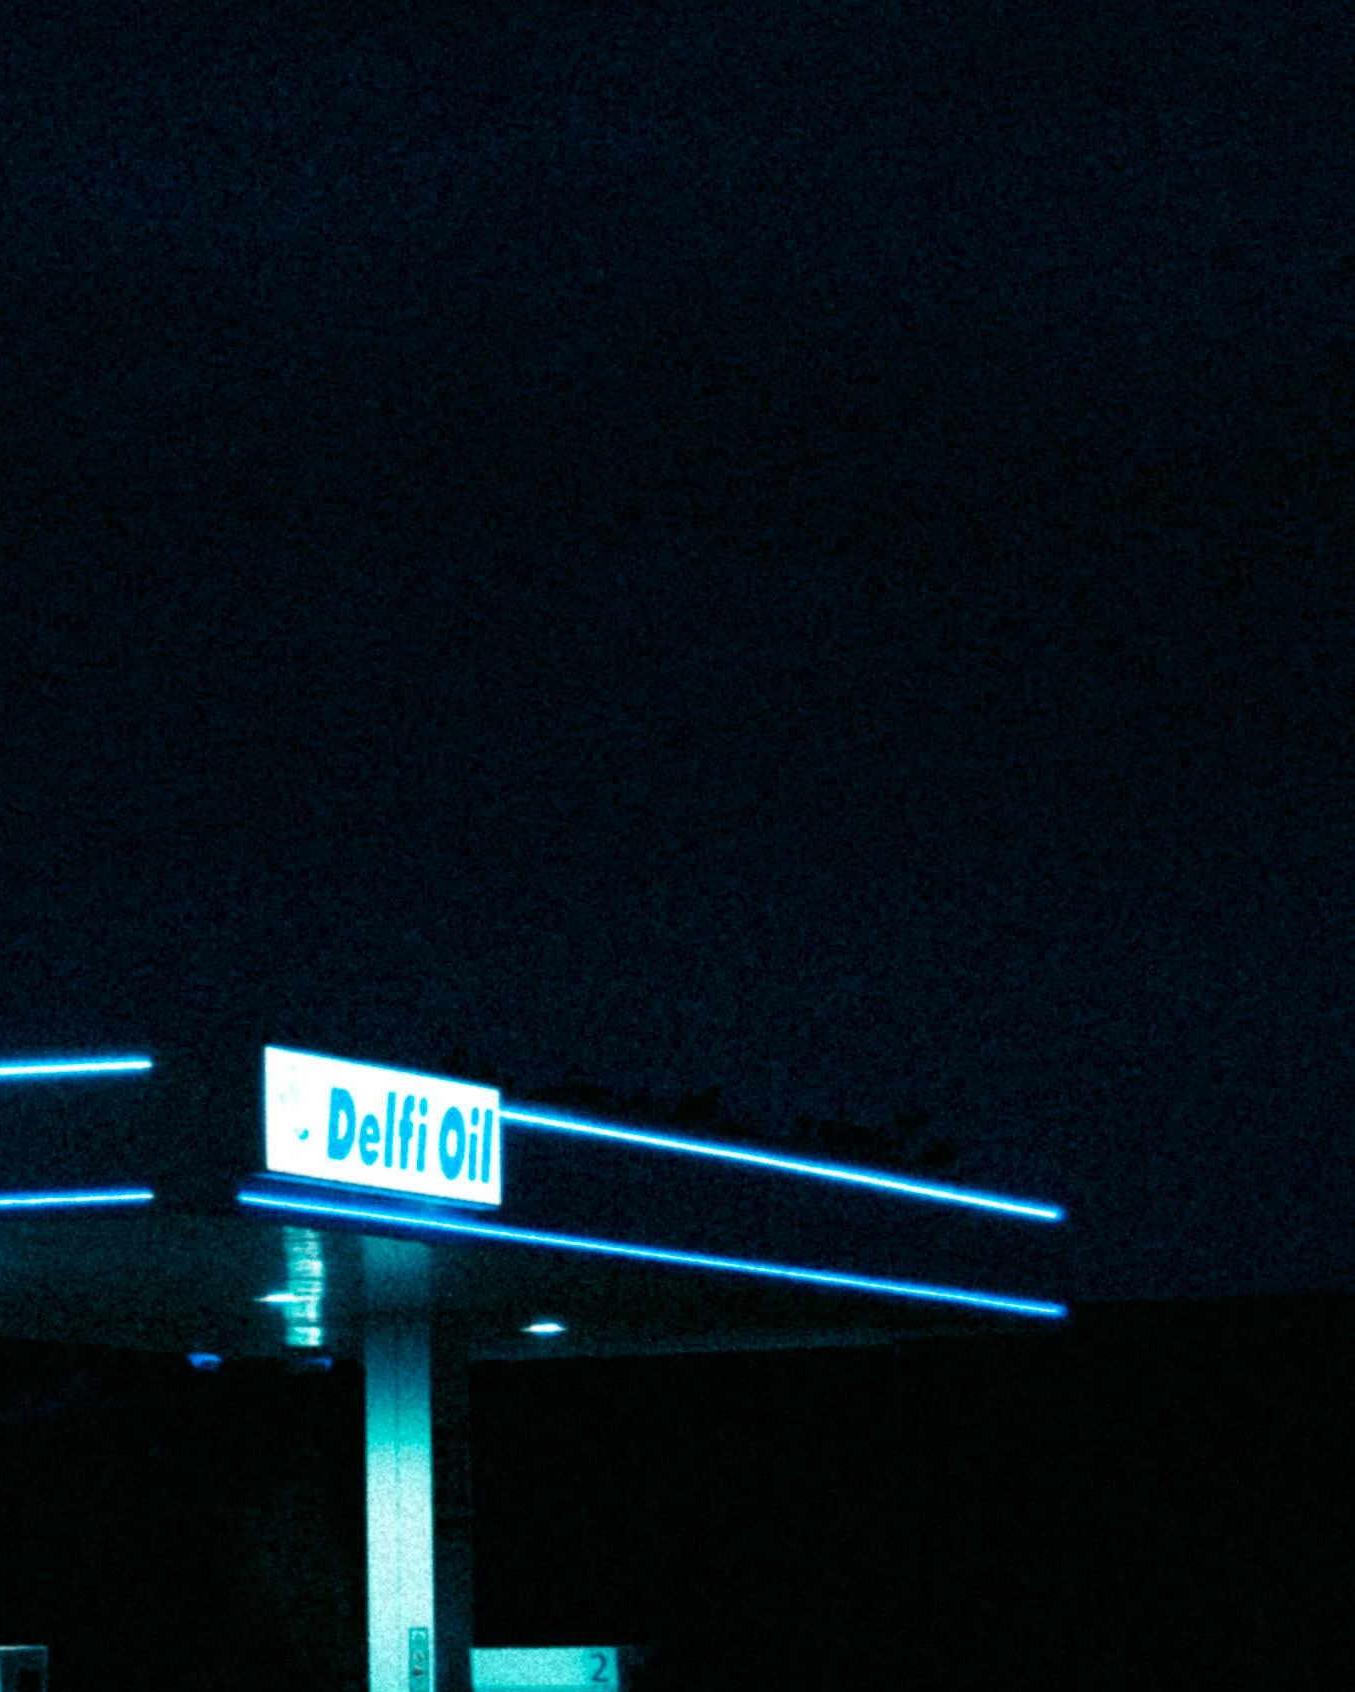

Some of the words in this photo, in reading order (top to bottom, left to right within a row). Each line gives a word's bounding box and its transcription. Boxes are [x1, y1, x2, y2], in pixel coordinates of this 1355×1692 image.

[327, 1087, 429, 1172] Delfi
[439, 1106, 493, 1184] Oil
[591, 1653, 609, 1682] 2
